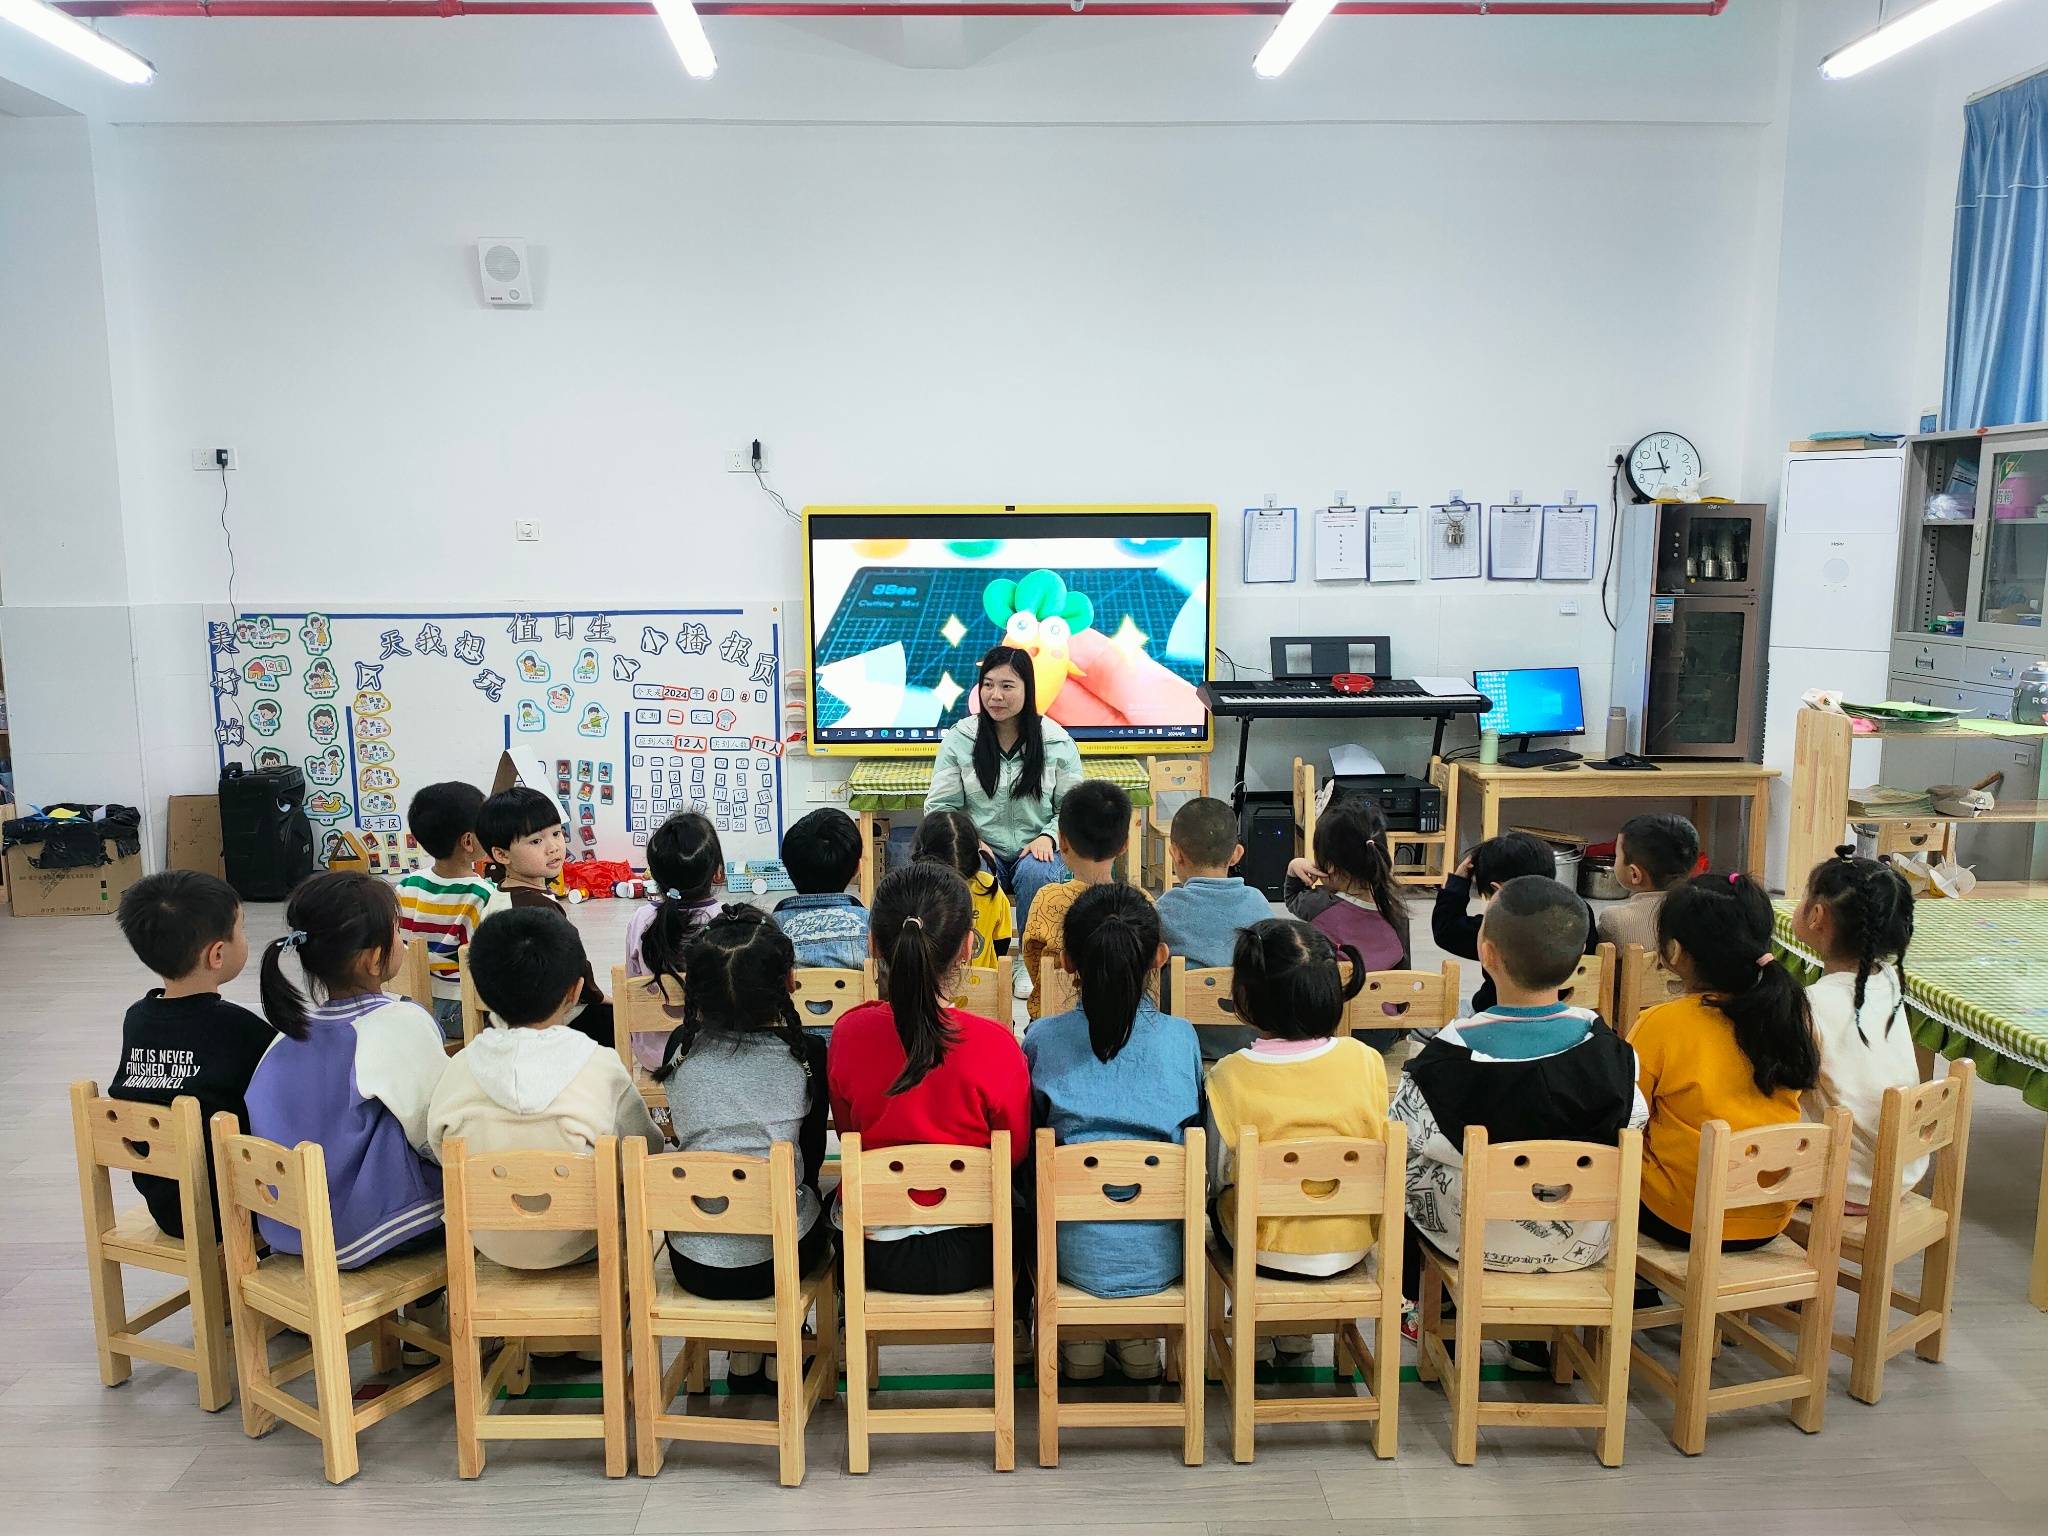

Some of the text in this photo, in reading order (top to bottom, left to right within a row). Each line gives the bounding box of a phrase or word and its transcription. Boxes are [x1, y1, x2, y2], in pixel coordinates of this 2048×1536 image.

[1650, 442, 1656, 451] 11
[1661, 439, 1669, 449] 12
[1682, 454, 1689, 463] 2
[1685, 465, 1691, 475] 3
[1639, 474, 1645, 483] 8
[1681, 478, 1688, 486] 4
[1647, 483, 1654, 492] 7
[505, 613, 616, 644] 值日生
[612, 622, 780, 687] 小小播报员
[208, 621, 245, 747] 美好的
[664, 688, 687, 698] 2024
[678, 737, 704, 749] 12人
[754, 738, 780, 754] 11人
[693, 787, 702, 795] 10
[761, 793, 770, 801] 13
[672, 801, 681, 809] 16
[735, 806, 743, 814] 19
[718, 820, 727, 828] 25
[636, 835, 645, 843] 28
[131, 1048, 193, 1064] ART IS NEVER
[126, 1062, 200, 1078] FINISHED, ONLY
[122, 1075, 184, 1089] ABANDONED.
